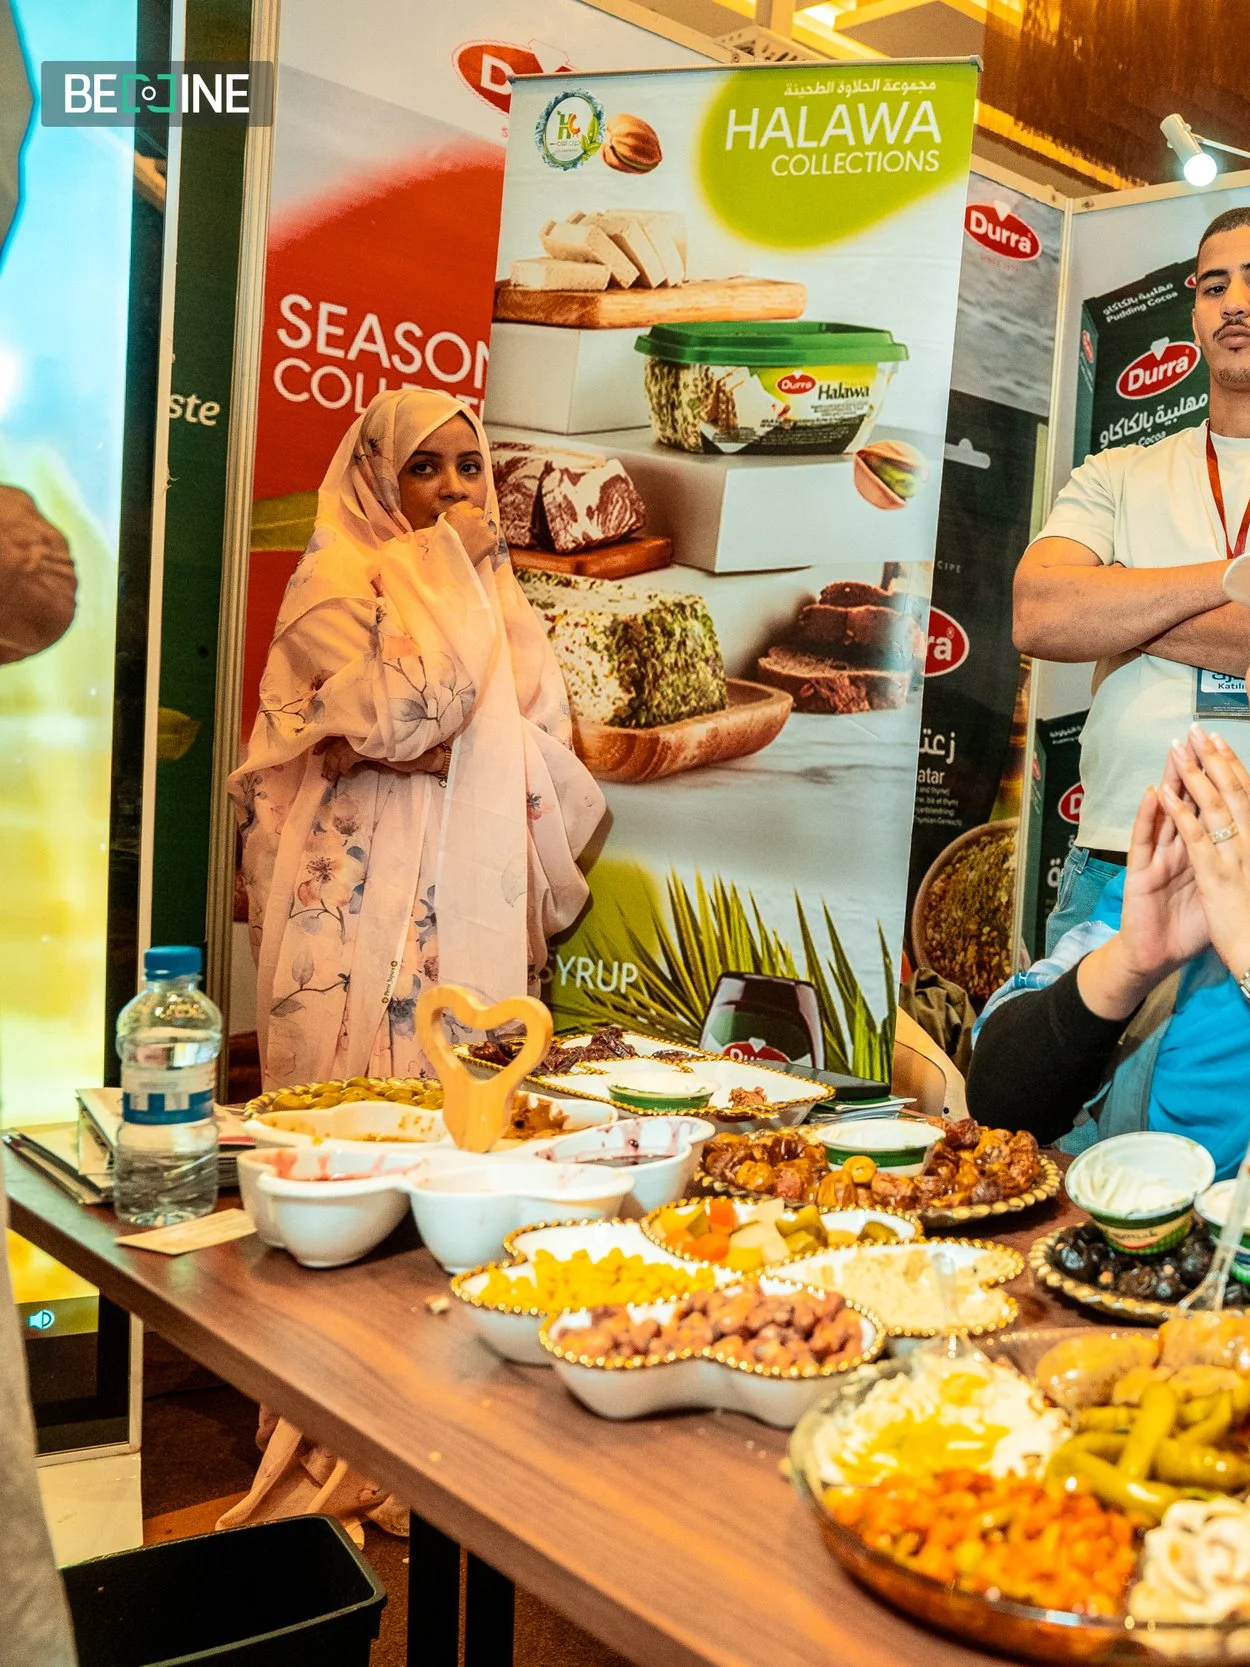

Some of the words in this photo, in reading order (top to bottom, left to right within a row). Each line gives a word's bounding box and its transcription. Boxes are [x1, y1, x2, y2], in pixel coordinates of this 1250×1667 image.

[837, 79, 880, 98] الحلاوة
[882, 79, 936, 95] مجموعة
[725, 100, 942, 151] HALAWA
[771, 150, 940, 176] COLLECTIONS
[970, 210, 1031, 254] Durra
[1106, 304, 1147, 324] Pudding
[1147, 291, 1178, 307] Cocoa
[781, 379, 811, 390] Durra
[1127, 354, 1190, 392] Durra
[818, 382, 869, 400] Halawa
[169, 394, 220, 426] ste
[1156, 393, 1209, 425] مهلبية
[1099, 413, 1154, 449] بالكاكاو
[937, 561, 962, 574] CIPE
[919, 728, 956, 764] زعت
[917, 768, 945, 785] atar
[556, 954, 638, 994] YRUP
